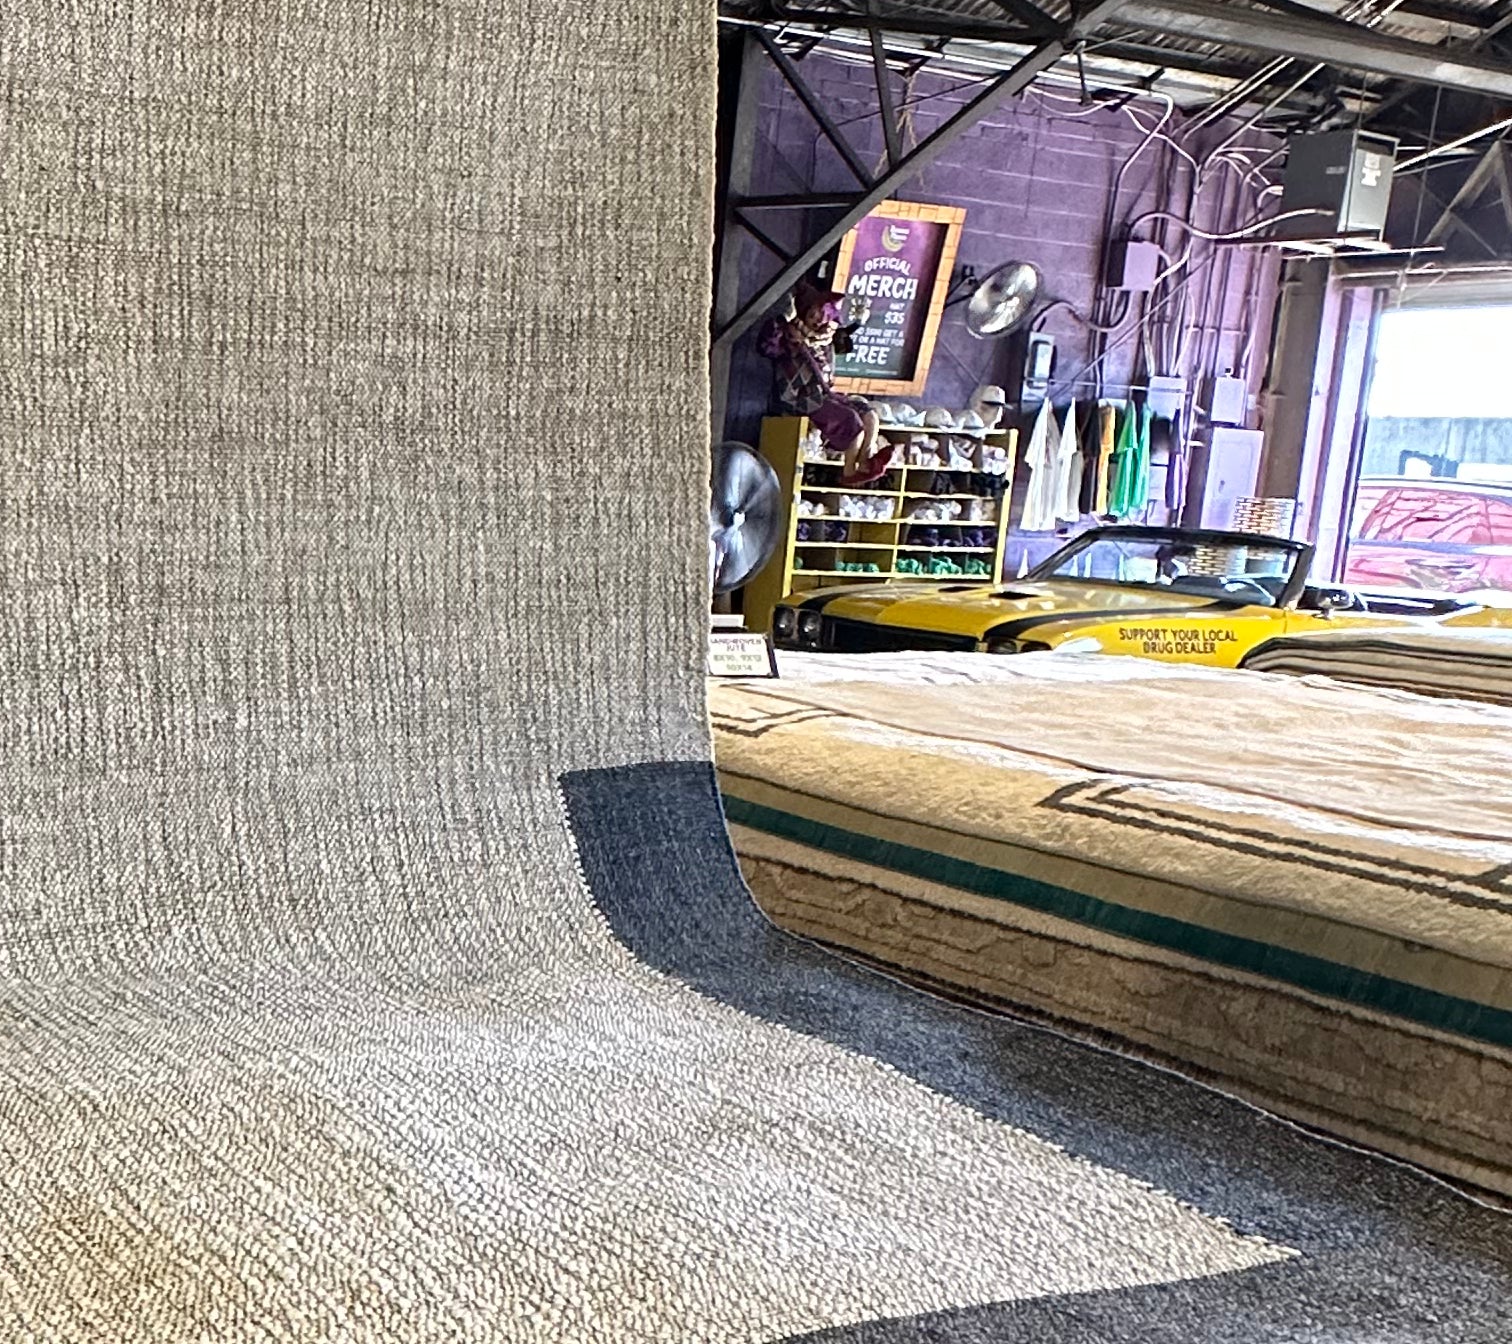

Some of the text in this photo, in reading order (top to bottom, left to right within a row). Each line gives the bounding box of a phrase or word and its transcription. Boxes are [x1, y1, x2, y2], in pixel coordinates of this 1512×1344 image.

[864, 257, 911, 276] OFFICIAL
[848, 274, 919, 300] MERCH
[845, 344, 890, 365] FREE
[1119, 627, 1238, 642] SUPPORT YOUR LOCAL
[1143, 641, 1216, 654] DRUG DEALER
